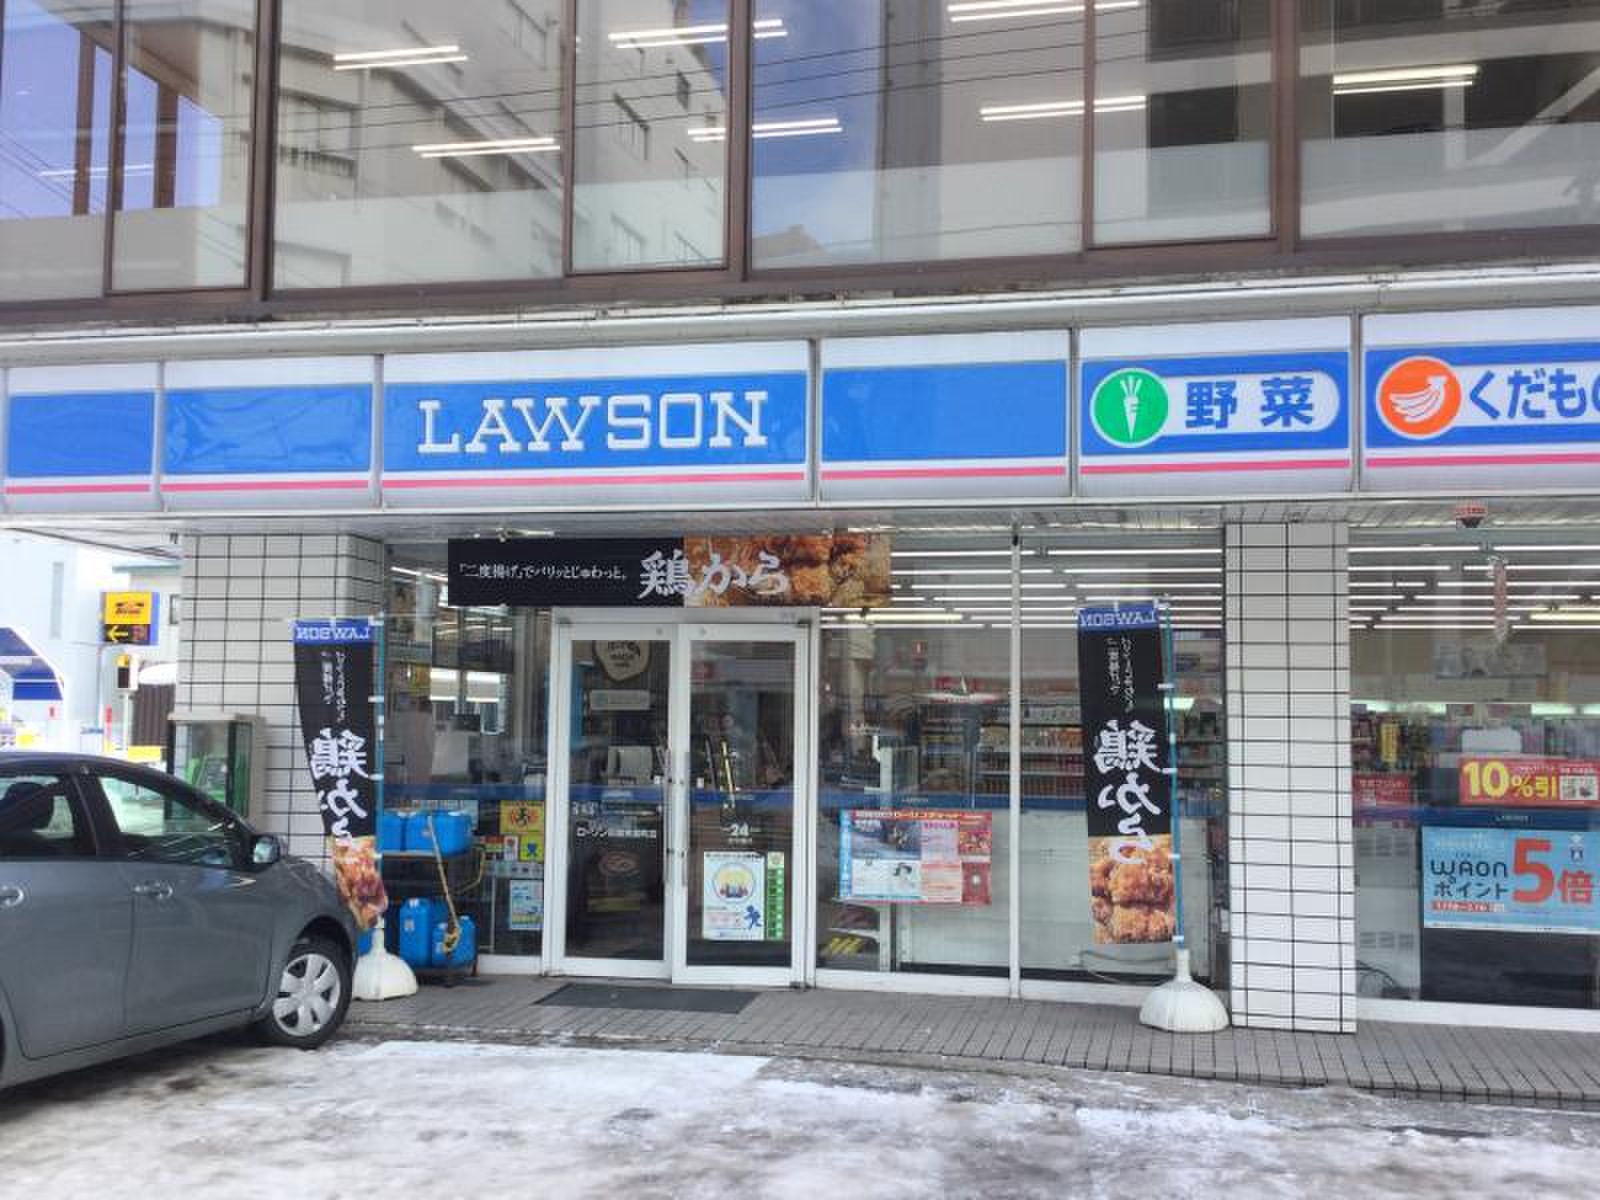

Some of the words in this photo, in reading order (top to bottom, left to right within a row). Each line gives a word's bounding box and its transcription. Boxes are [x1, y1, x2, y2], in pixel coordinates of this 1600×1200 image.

[417, 391, 768, 453] LAWSON
[1185, 376, 1314, 429] 野菜
[636, 549, 790, 598] 鶏から
[1434, 875, 1510, 900] ポイント
[1512, 837, 1594, 905] 5倍
